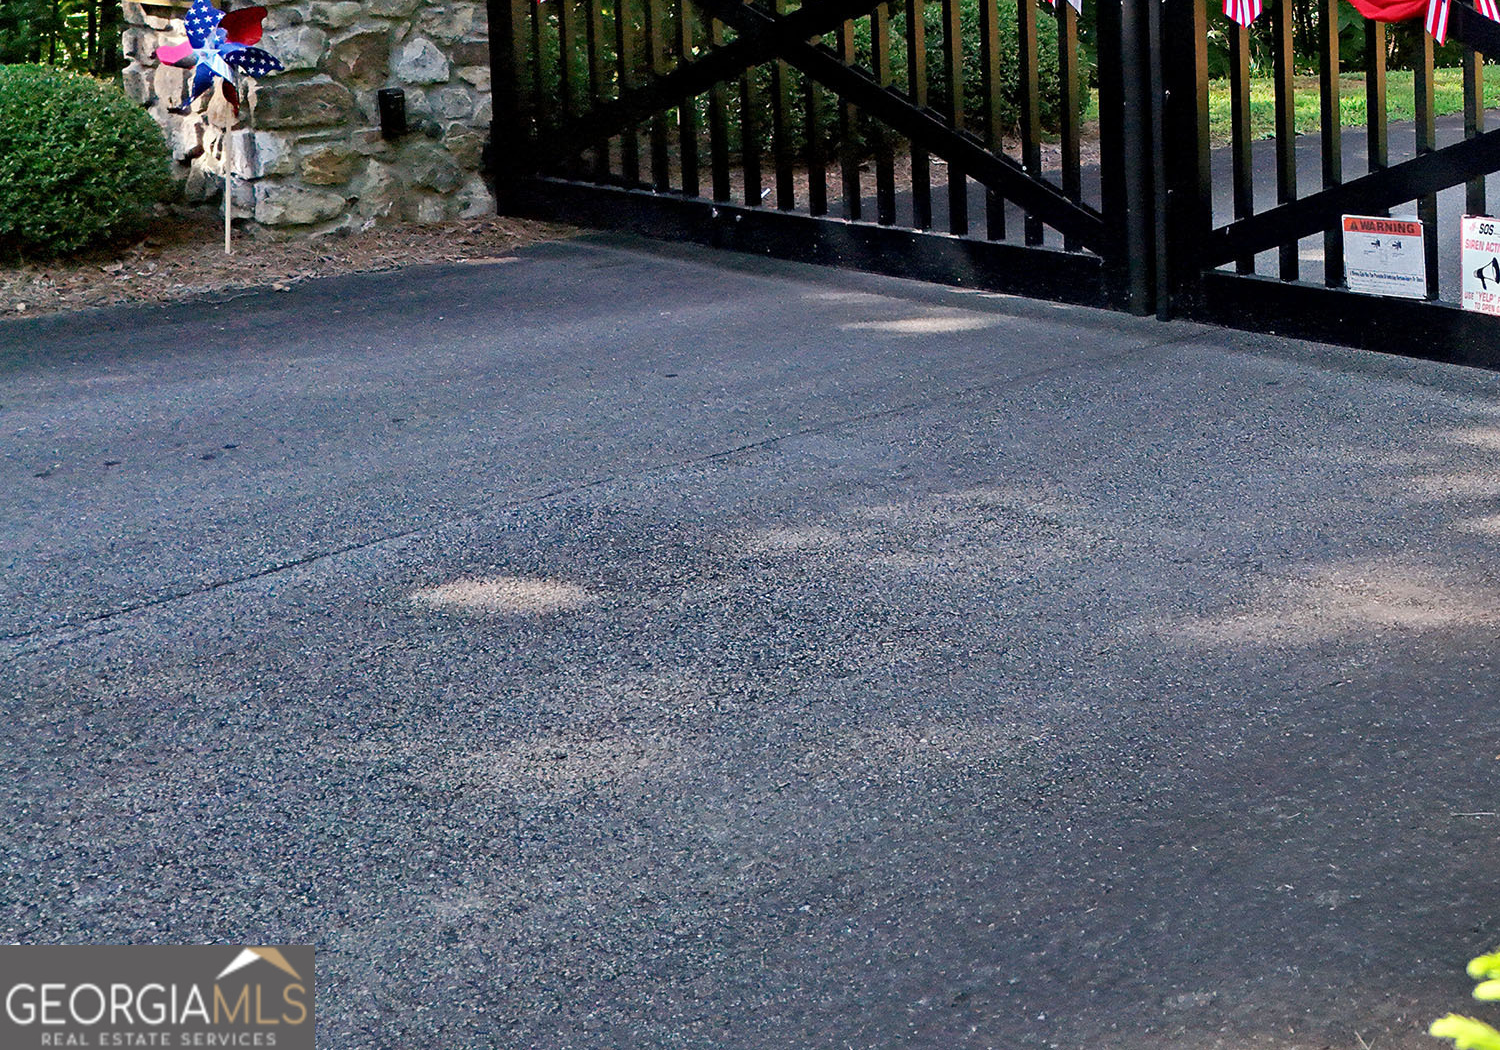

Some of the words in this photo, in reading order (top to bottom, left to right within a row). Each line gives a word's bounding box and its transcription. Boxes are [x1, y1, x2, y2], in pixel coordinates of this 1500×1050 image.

[1360, 221, 1415, 234] WARNING
[1479, 223, 1494, 236] SOS
[1465, 239, 1484, 251] SIREN
[1482, 303, 1495, 312] OPEN
